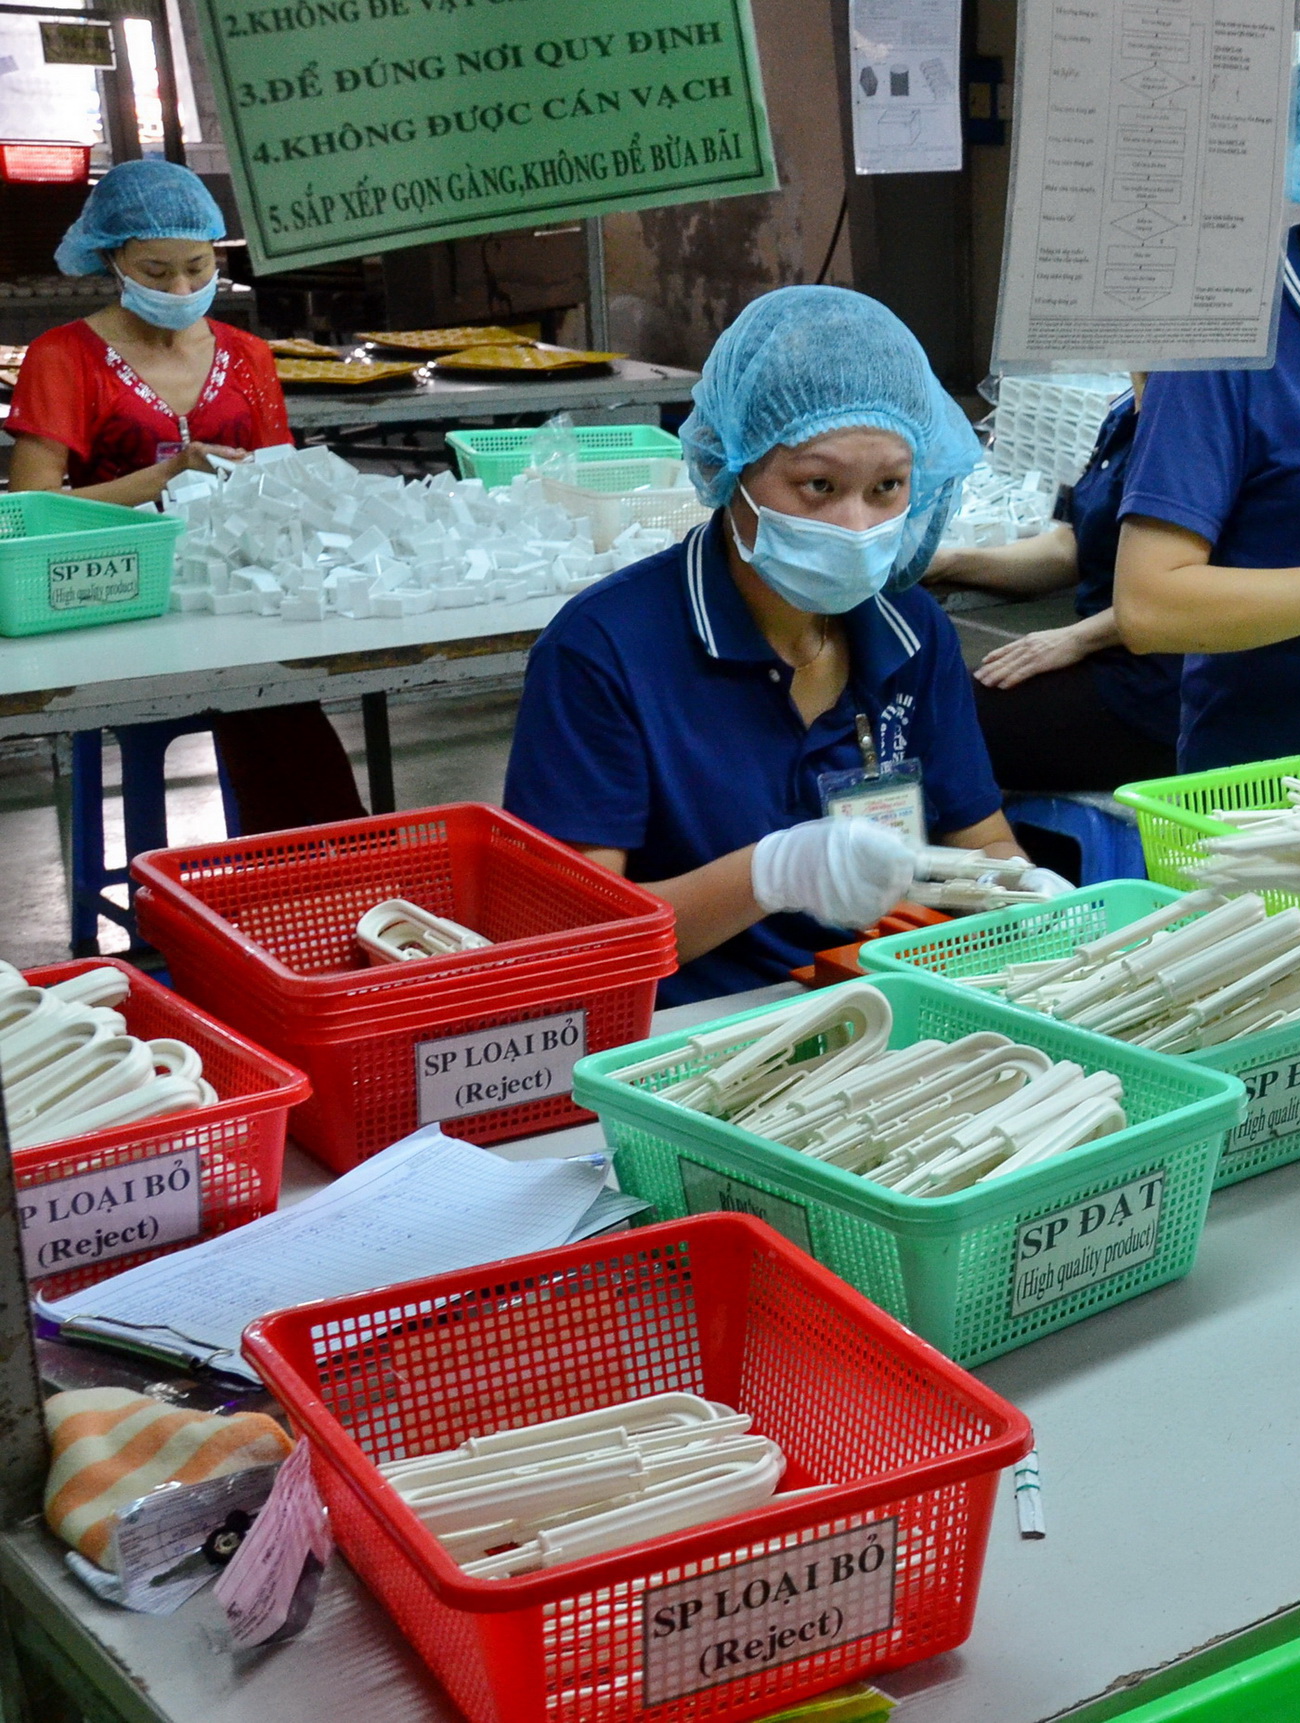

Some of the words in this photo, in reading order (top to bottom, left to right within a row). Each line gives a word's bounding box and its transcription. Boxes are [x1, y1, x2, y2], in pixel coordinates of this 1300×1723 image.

[239, 60, 323, 108] 3.ĐỂ
[334, 57, 446, 94] ĐÚNG
[455, 43, 523, 76] NƠI
[534, 34, 615, 69] QUY
[626, 21, 724, 54] ĐỊNH
[253, 118, 418, 165] 4.KHÔNG
[427, 101, 533, 138] ĐƯỢC
[542, 88, 622, 120] CÁN
[629, 76, 734, 109] VẠCH
[340, 175, 388, 222] XẾP
[391, 176, 445, 214] GỌN
[612, 132, 646, 178] ĐỂ
[701, 128, 745, 165] BÃI
[52, 564, 80, 582] SP
[86, 557, 136, 578] ĐẠT
[424, 1050, 457, 1078] SP
[464, 1033, 536, 1070] LOẠI
[541, 1016, 580, 1051] BỎ
[455, 1066, 553, 1109] (Reject)
[1243, 1070, 1280, 1103] SP
[20, 1204, 38, 1231] P
[48, 1179, 136, 1224] LOẠI
[145, 1158, 192, 1200] BỎ
[1020, 1217, 1070, 1262] SP
[1077, 1177, 1164, 1239] ĐẠT
[37, 1215, 160, 1269] (Reject)
[1016, 1261, 1055, 1308] (High
[1056, 1244, 1102, 1292] quality
[1102, 1218, 1157, 1274] product)
[653, 1598, 704, 1640] SP
[714, 1560, 820, 1621] LOẠI
[829, 1532, 886, 1587] BỎ
[698, 1605, 844, 1679] (Reject)
